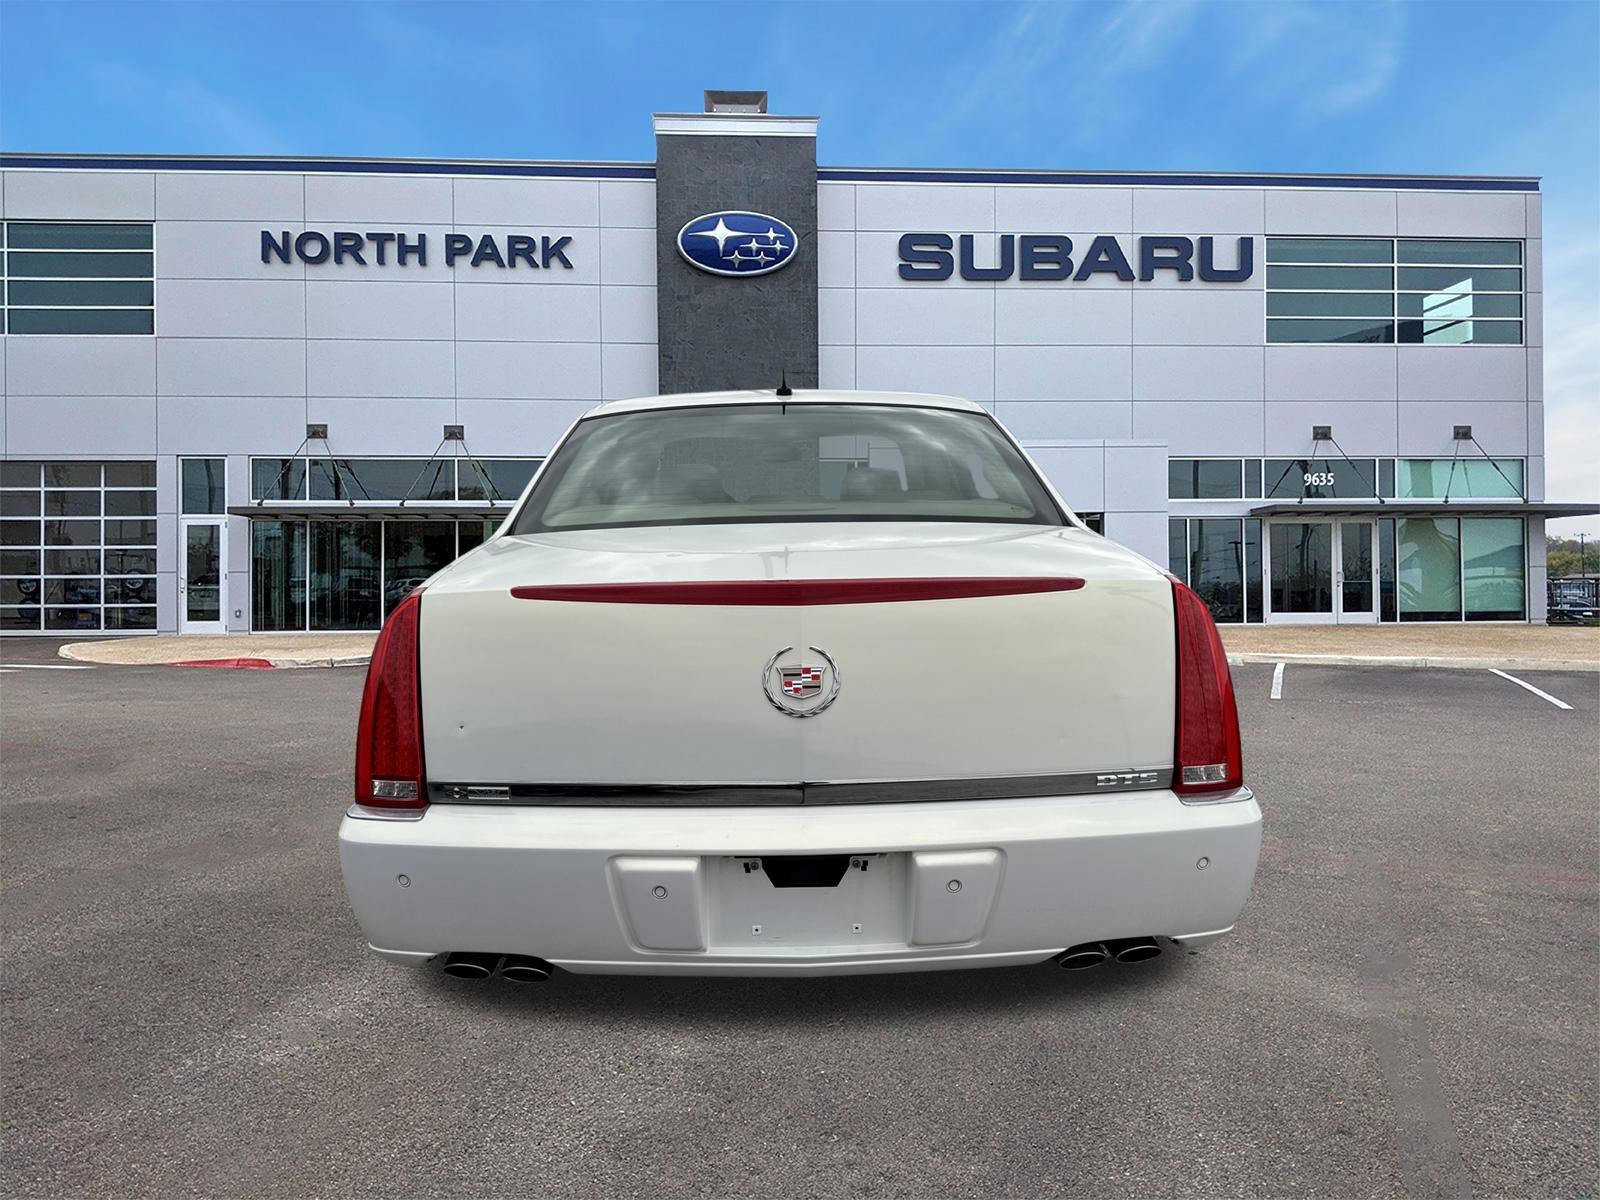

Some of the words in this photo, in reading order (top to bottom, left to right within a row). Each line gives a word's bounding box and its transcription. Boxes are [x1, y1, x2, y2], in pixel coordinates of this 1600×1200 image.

[260, 230, 427, 267] NORTH
[445, 233, 574, 269] PARK
[898, 233, 1254, 282] SUBARU
[1303, 472, 1335, 486] 9635
[1096, 772, 1158, 786] DTS
